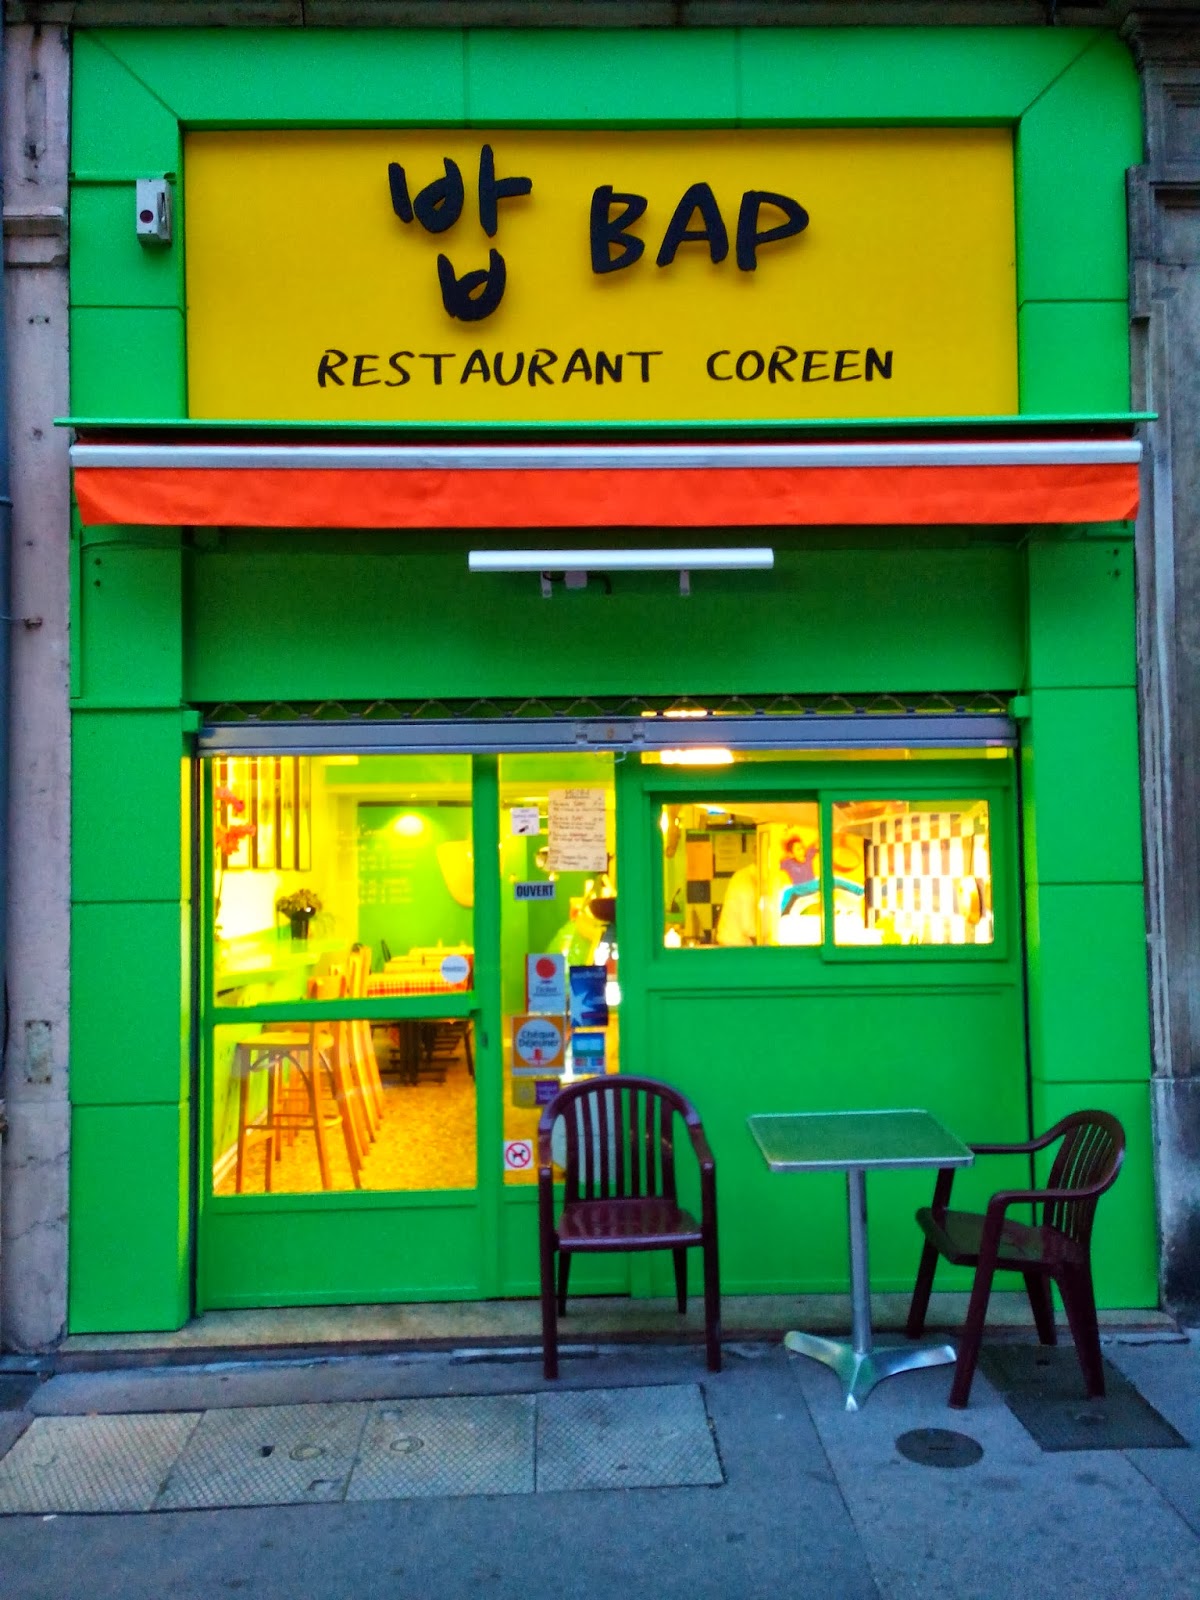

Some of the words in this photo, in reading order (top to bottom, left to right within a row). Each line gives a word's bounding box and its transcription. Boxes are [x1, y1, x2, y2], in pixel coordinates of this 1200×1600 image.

[388, 144, 532, 322] 밥
[590, 182, 810, 274] BAP
[318, 348, 663, 388] RESTAURANT
[706, 346, 893, 384] COREEN
[516, 884, 554, 898] OUVERT
